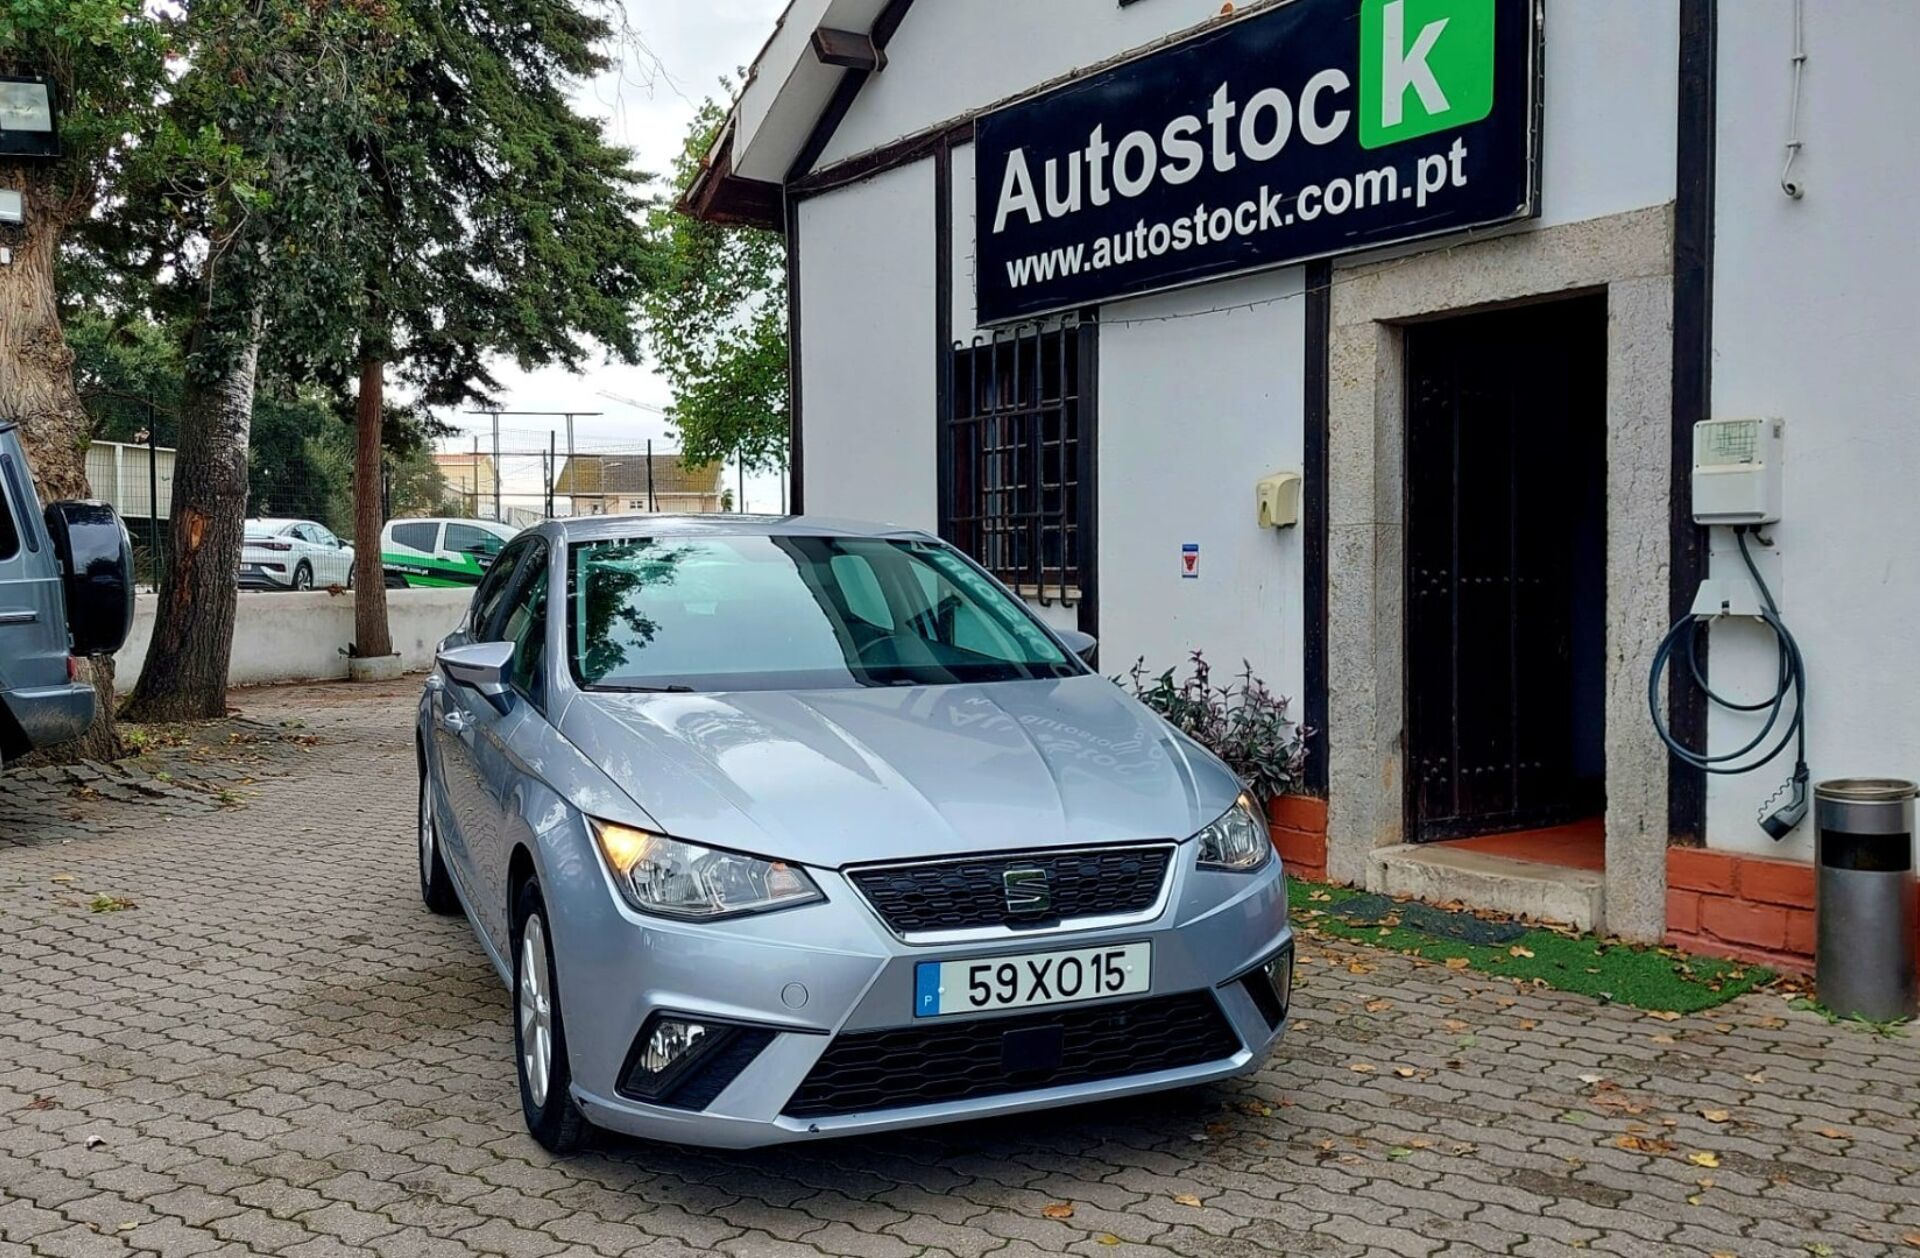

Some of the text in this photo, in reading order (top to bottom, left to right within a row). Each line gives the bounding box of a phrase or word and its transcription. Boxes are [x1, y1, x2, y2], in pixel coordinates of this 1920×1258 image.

[993, 0, 1450, 233] Autostock
[1006, 136, 1467, 288] www.autostock.com.pt
[924, 995, 933, 1007] P
